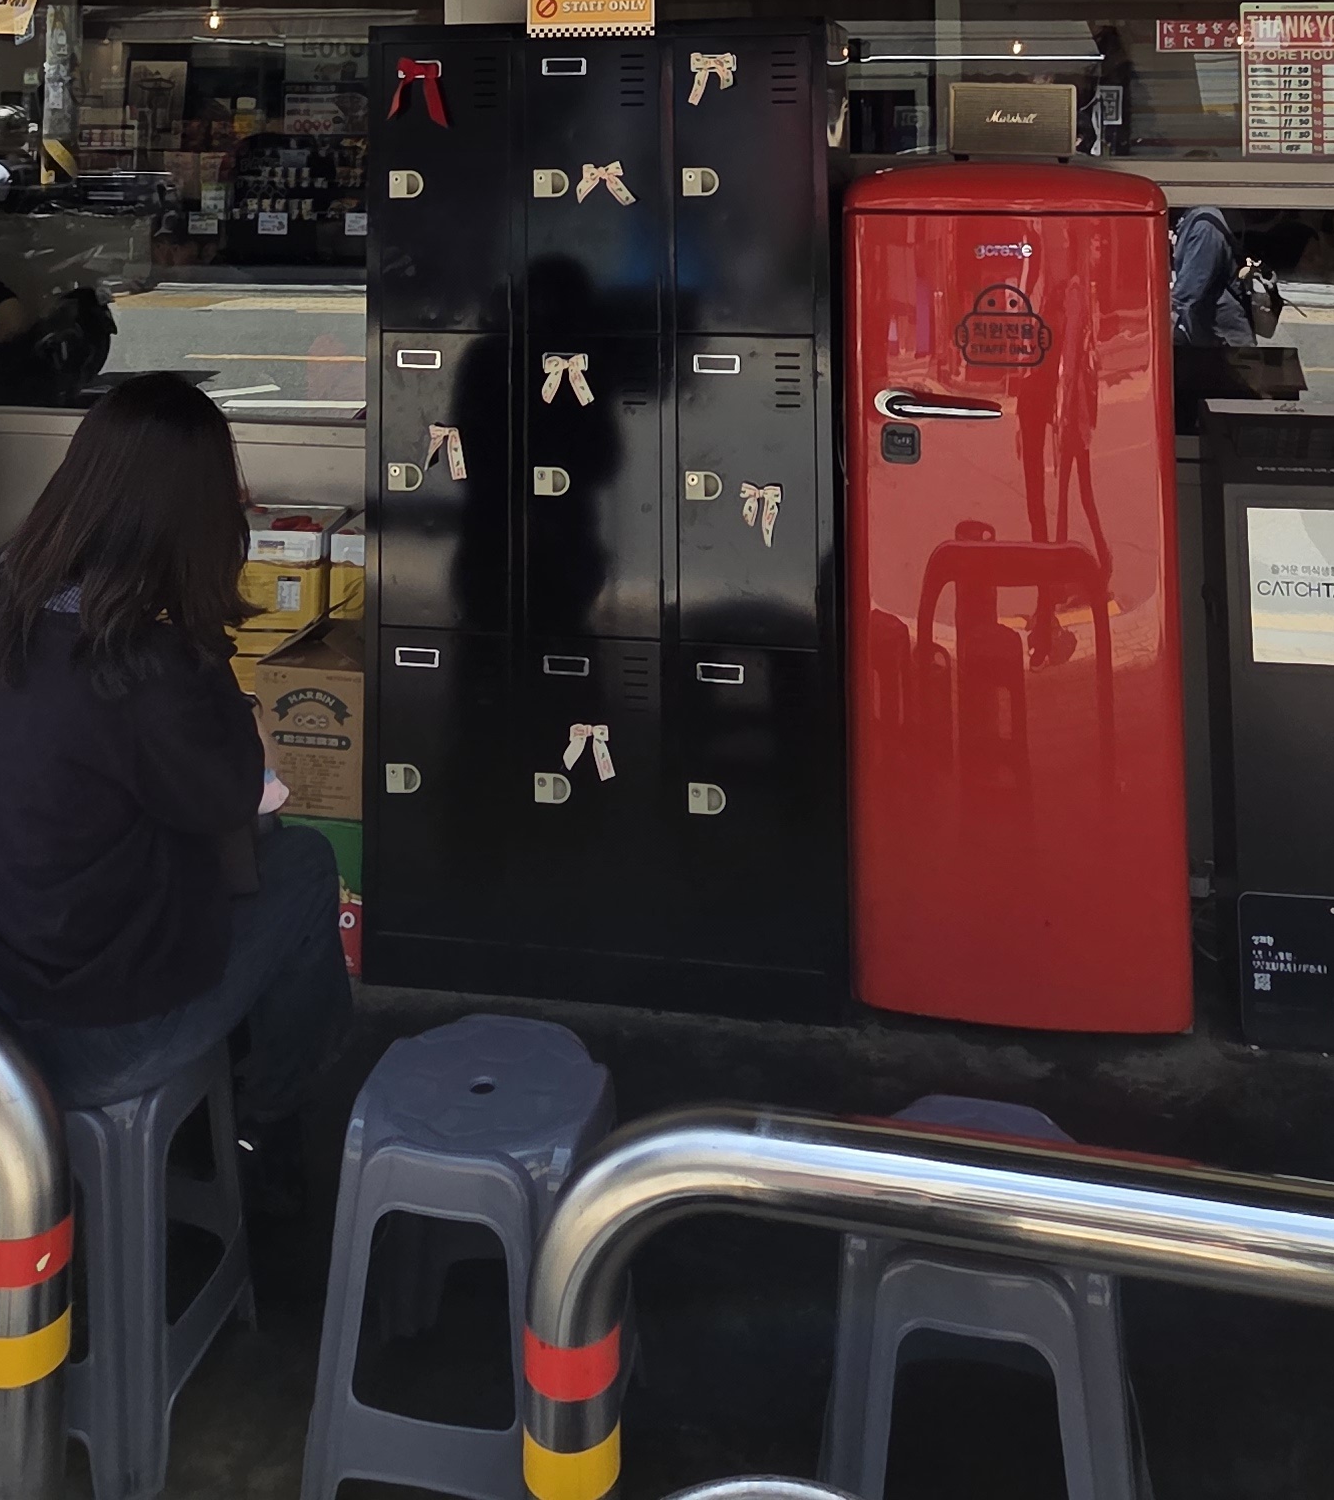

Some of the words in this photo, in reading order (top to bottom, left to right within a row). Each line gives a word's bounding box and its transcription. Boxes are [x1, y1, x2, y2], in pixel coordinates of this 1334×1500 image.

[562, 0, 605, 13] STAFF
[608, 0, 646, 11] ONLY
[1247, 15, 1312, 38] THANK
[1248, 50, 1298, 60] STORE
[986, 110, 1038, 123] Marshall
[974, 242, 1033, 260] gorenje
[973, 322, 1034, 340] 직원전용
[971, 343, 1007, 355] STAFF
[1010, 343, 1037, 355] ONLY
[297, 690, 336, 707] HARBIN
